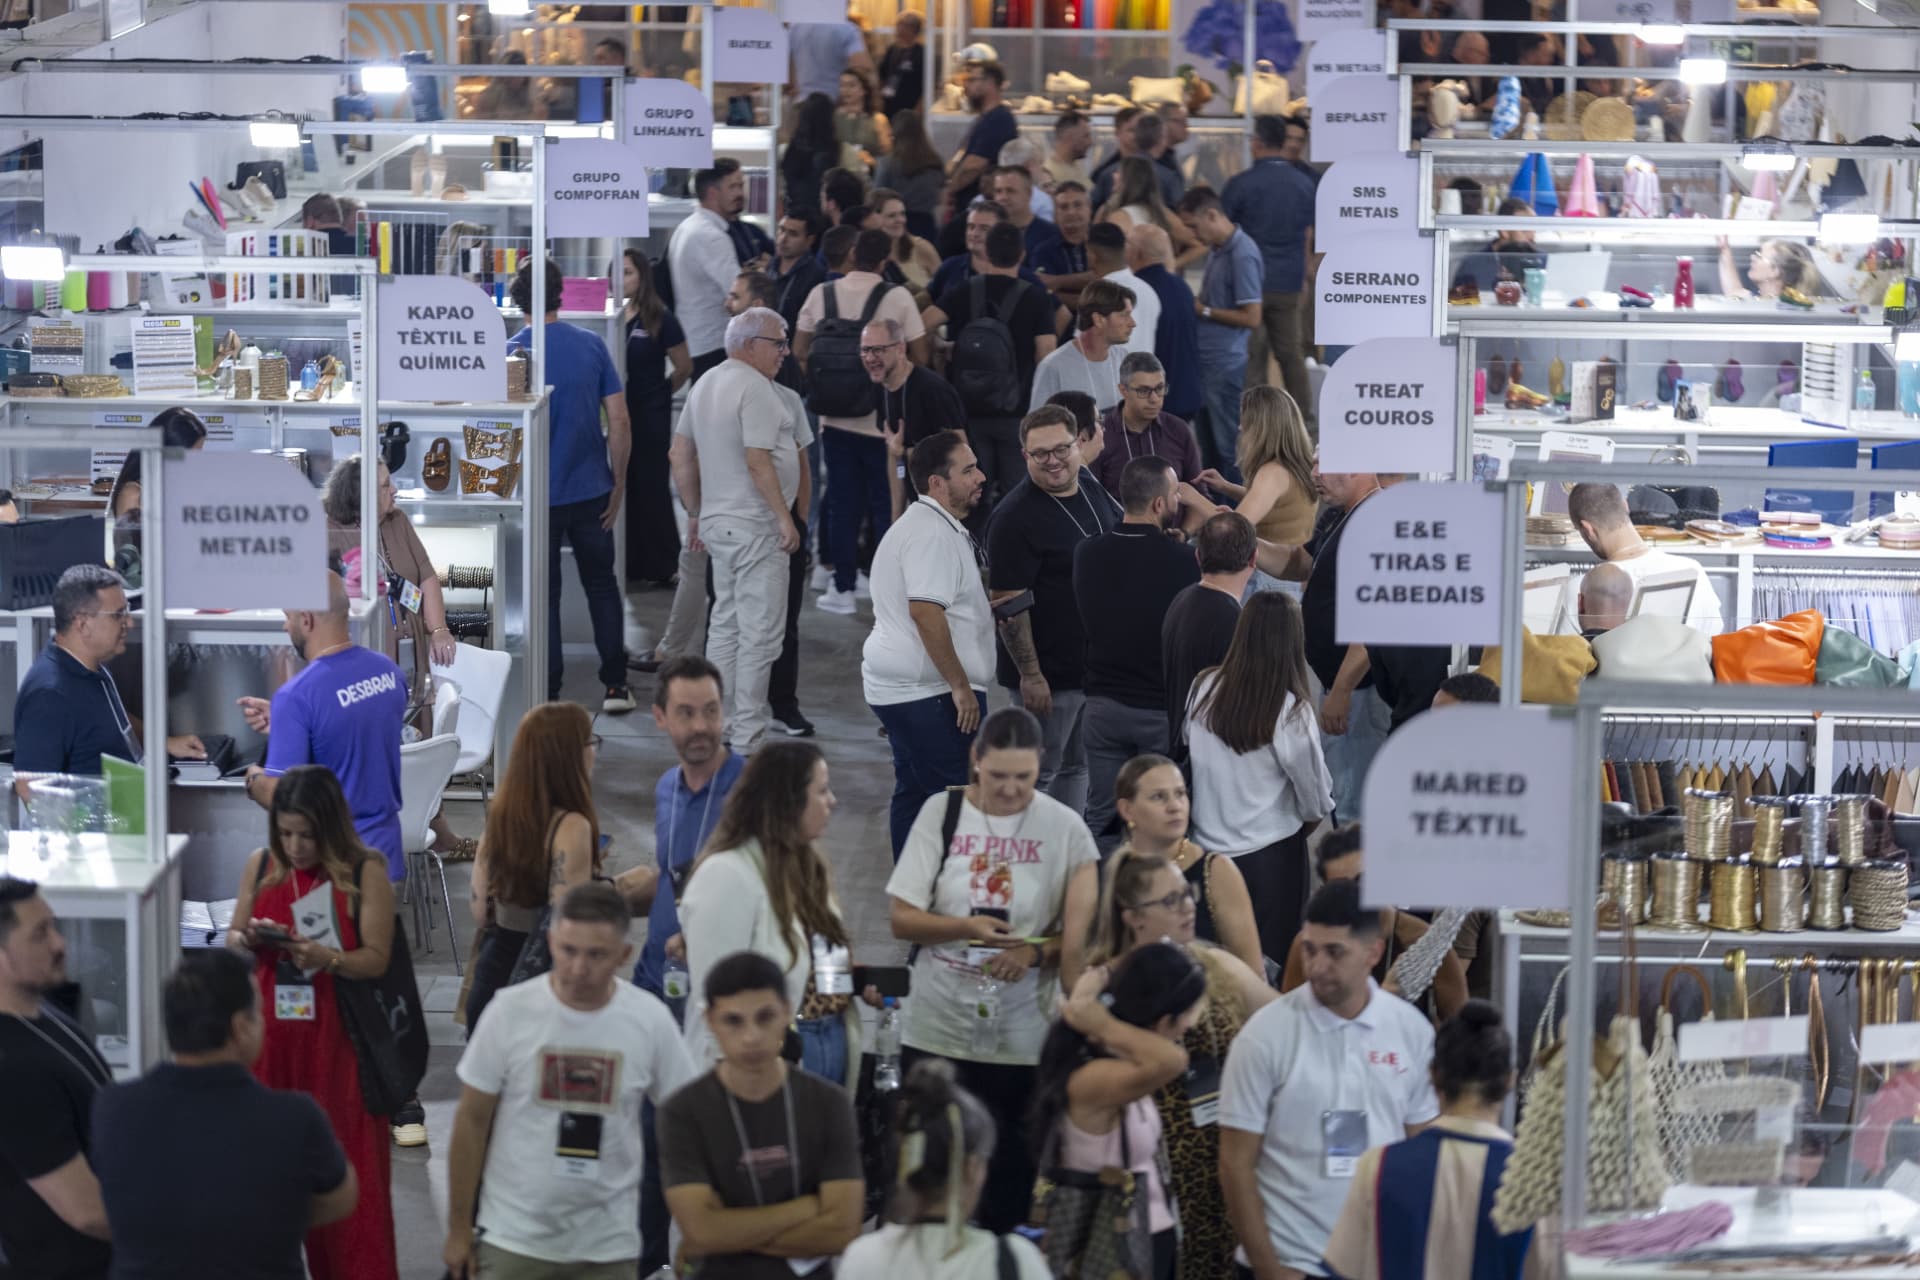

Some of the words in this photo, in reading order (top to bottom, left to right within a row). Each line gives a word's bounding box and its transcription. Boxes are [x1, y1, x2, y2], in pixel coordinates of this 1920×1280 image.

[1335, 63, 1383, 73] METAIS
[644, 108, 694, 120] GRUPO
[1325, 112, 1387, 123] BEPLAST
[633, 126, 705, 138] LINHANYL
[572, 172, 620, 183] GRUPO
[553, 189, 640, 201] COMPOFRAN
[1352, 187, 1387, 199] SMS
[1339, 206, 1399, 219] METAIS
[1332, 272, 1420, 286] SERRANO
[1323, 292, 1427, 305] COMPONENTES
[407, 306, 475, 320] KAPAO
[396, 328, 468, 345] TÊXTIL
[474, 331, 486, 345] E
[399, 353, 486, 371] QUÍMICA
[1355, 384, 1425, 399] TREAT
[1345, 410, 1434, 426] COUROS
[182, 506, 309, 524] REGINATO
[1395, 521, 1446, 539] E&E
[200, 537, 293, 555] METAIS
[1370, 554, 1447, 572] TIRAS
[1455, 554, 1471, 572] E
[1355, 585, 1485, 604] CABEDAIS
[1413, 773, 1528, 796] MARED
[984, 836, 1044, 863] PINK
